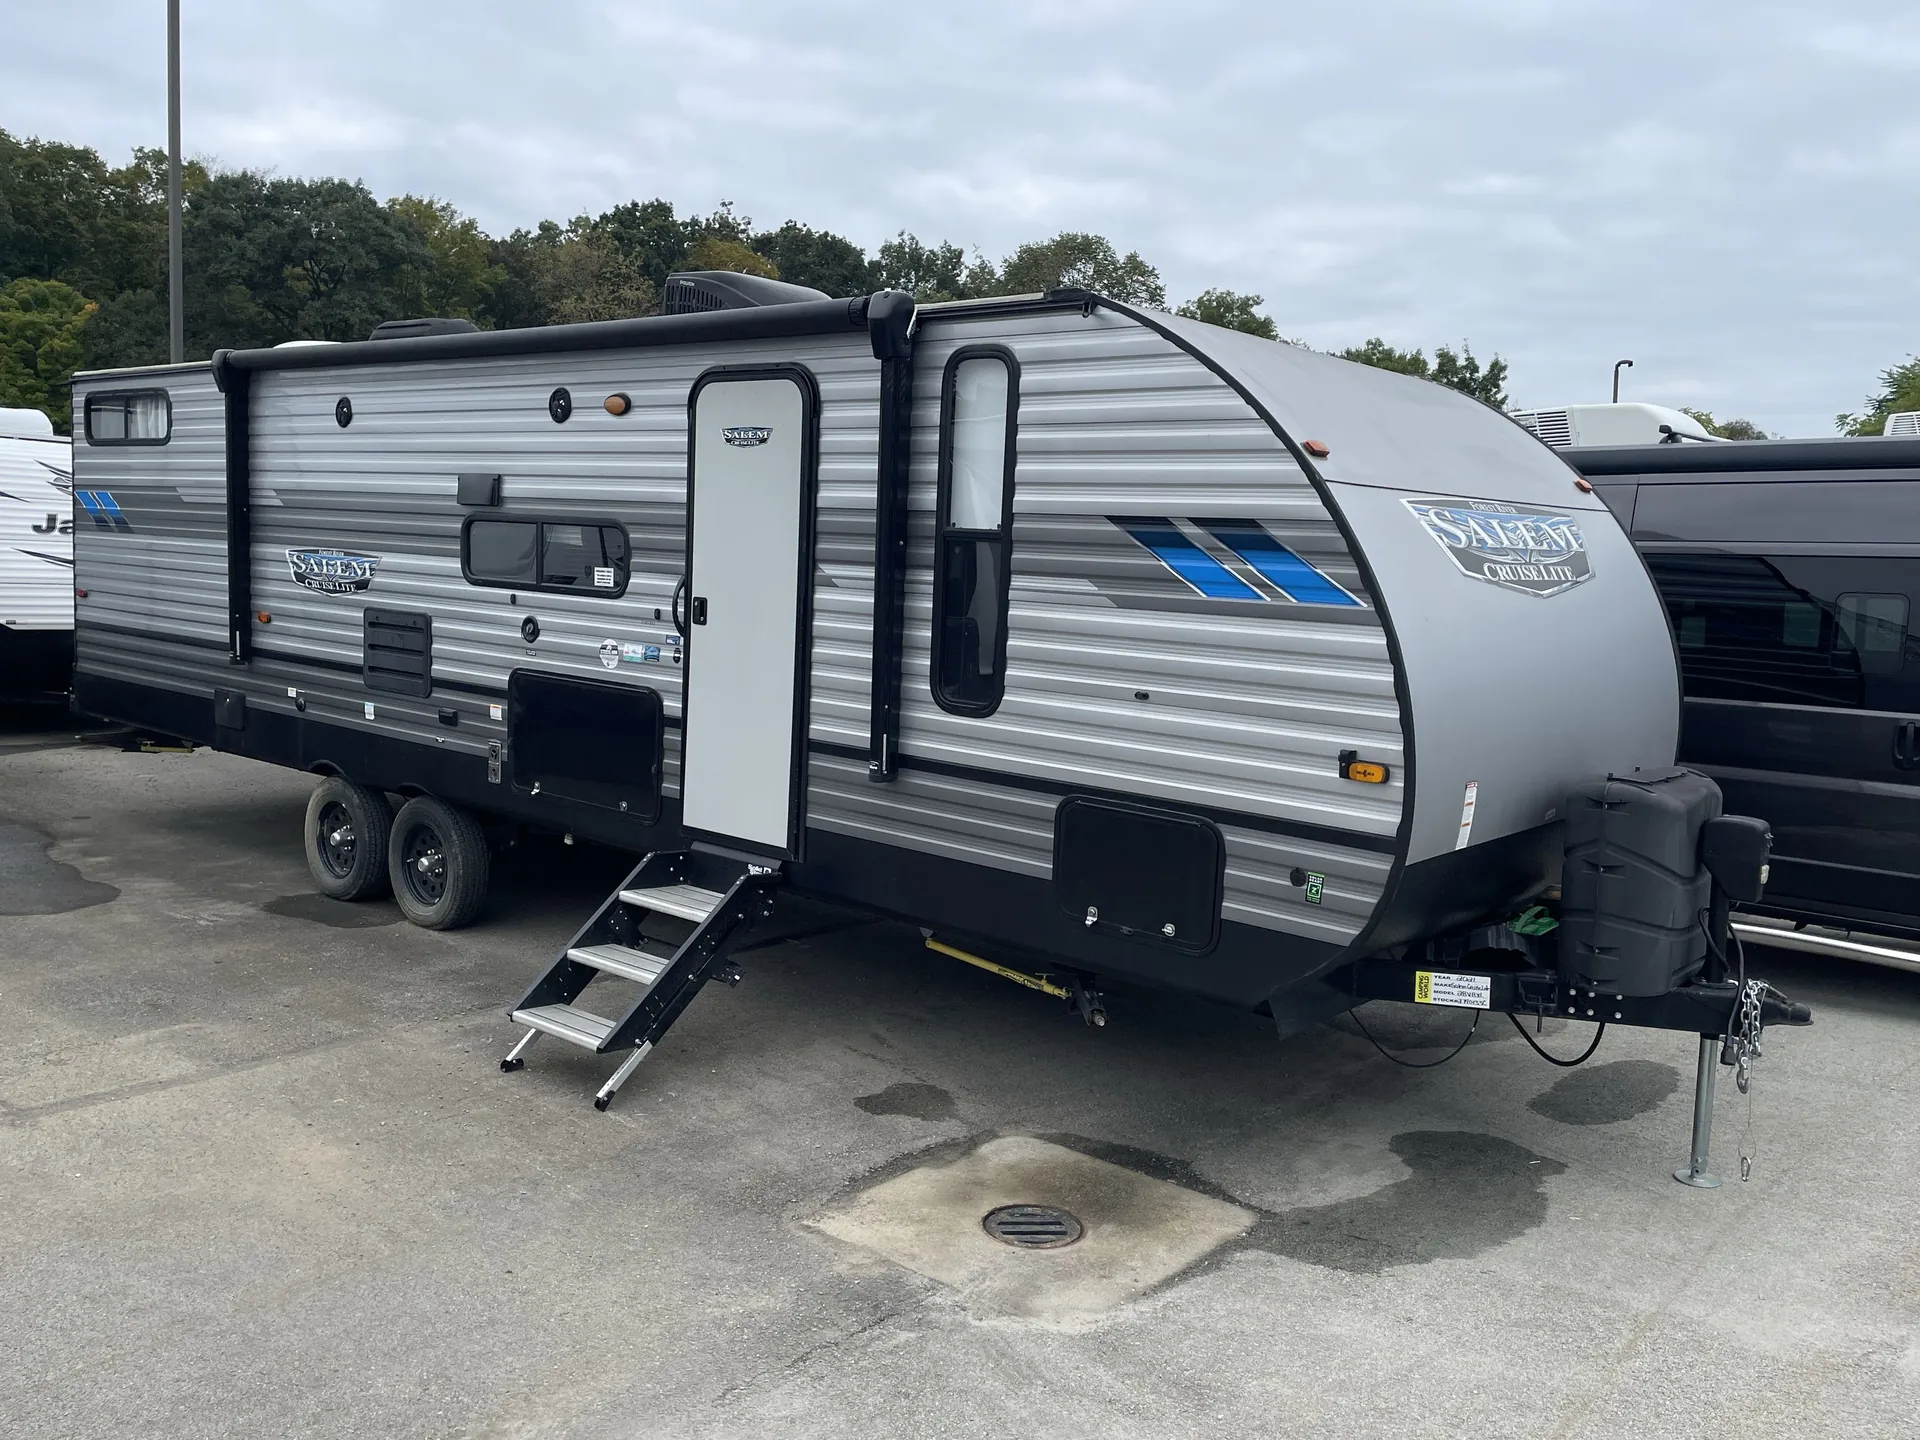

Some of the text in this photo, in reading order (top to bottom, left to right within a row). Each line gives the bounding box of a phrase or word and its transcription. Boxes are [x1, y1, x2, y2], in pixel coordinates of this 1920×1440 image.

[724, 430, 769, 439] SALEM
[1494, 504, 1519, 514] RIVER
[1428, 507, 1585, 552] SALEM
[292, 553, 373, 578] SALEM
[1483, 562, 1577, 582] CRUISELITE
